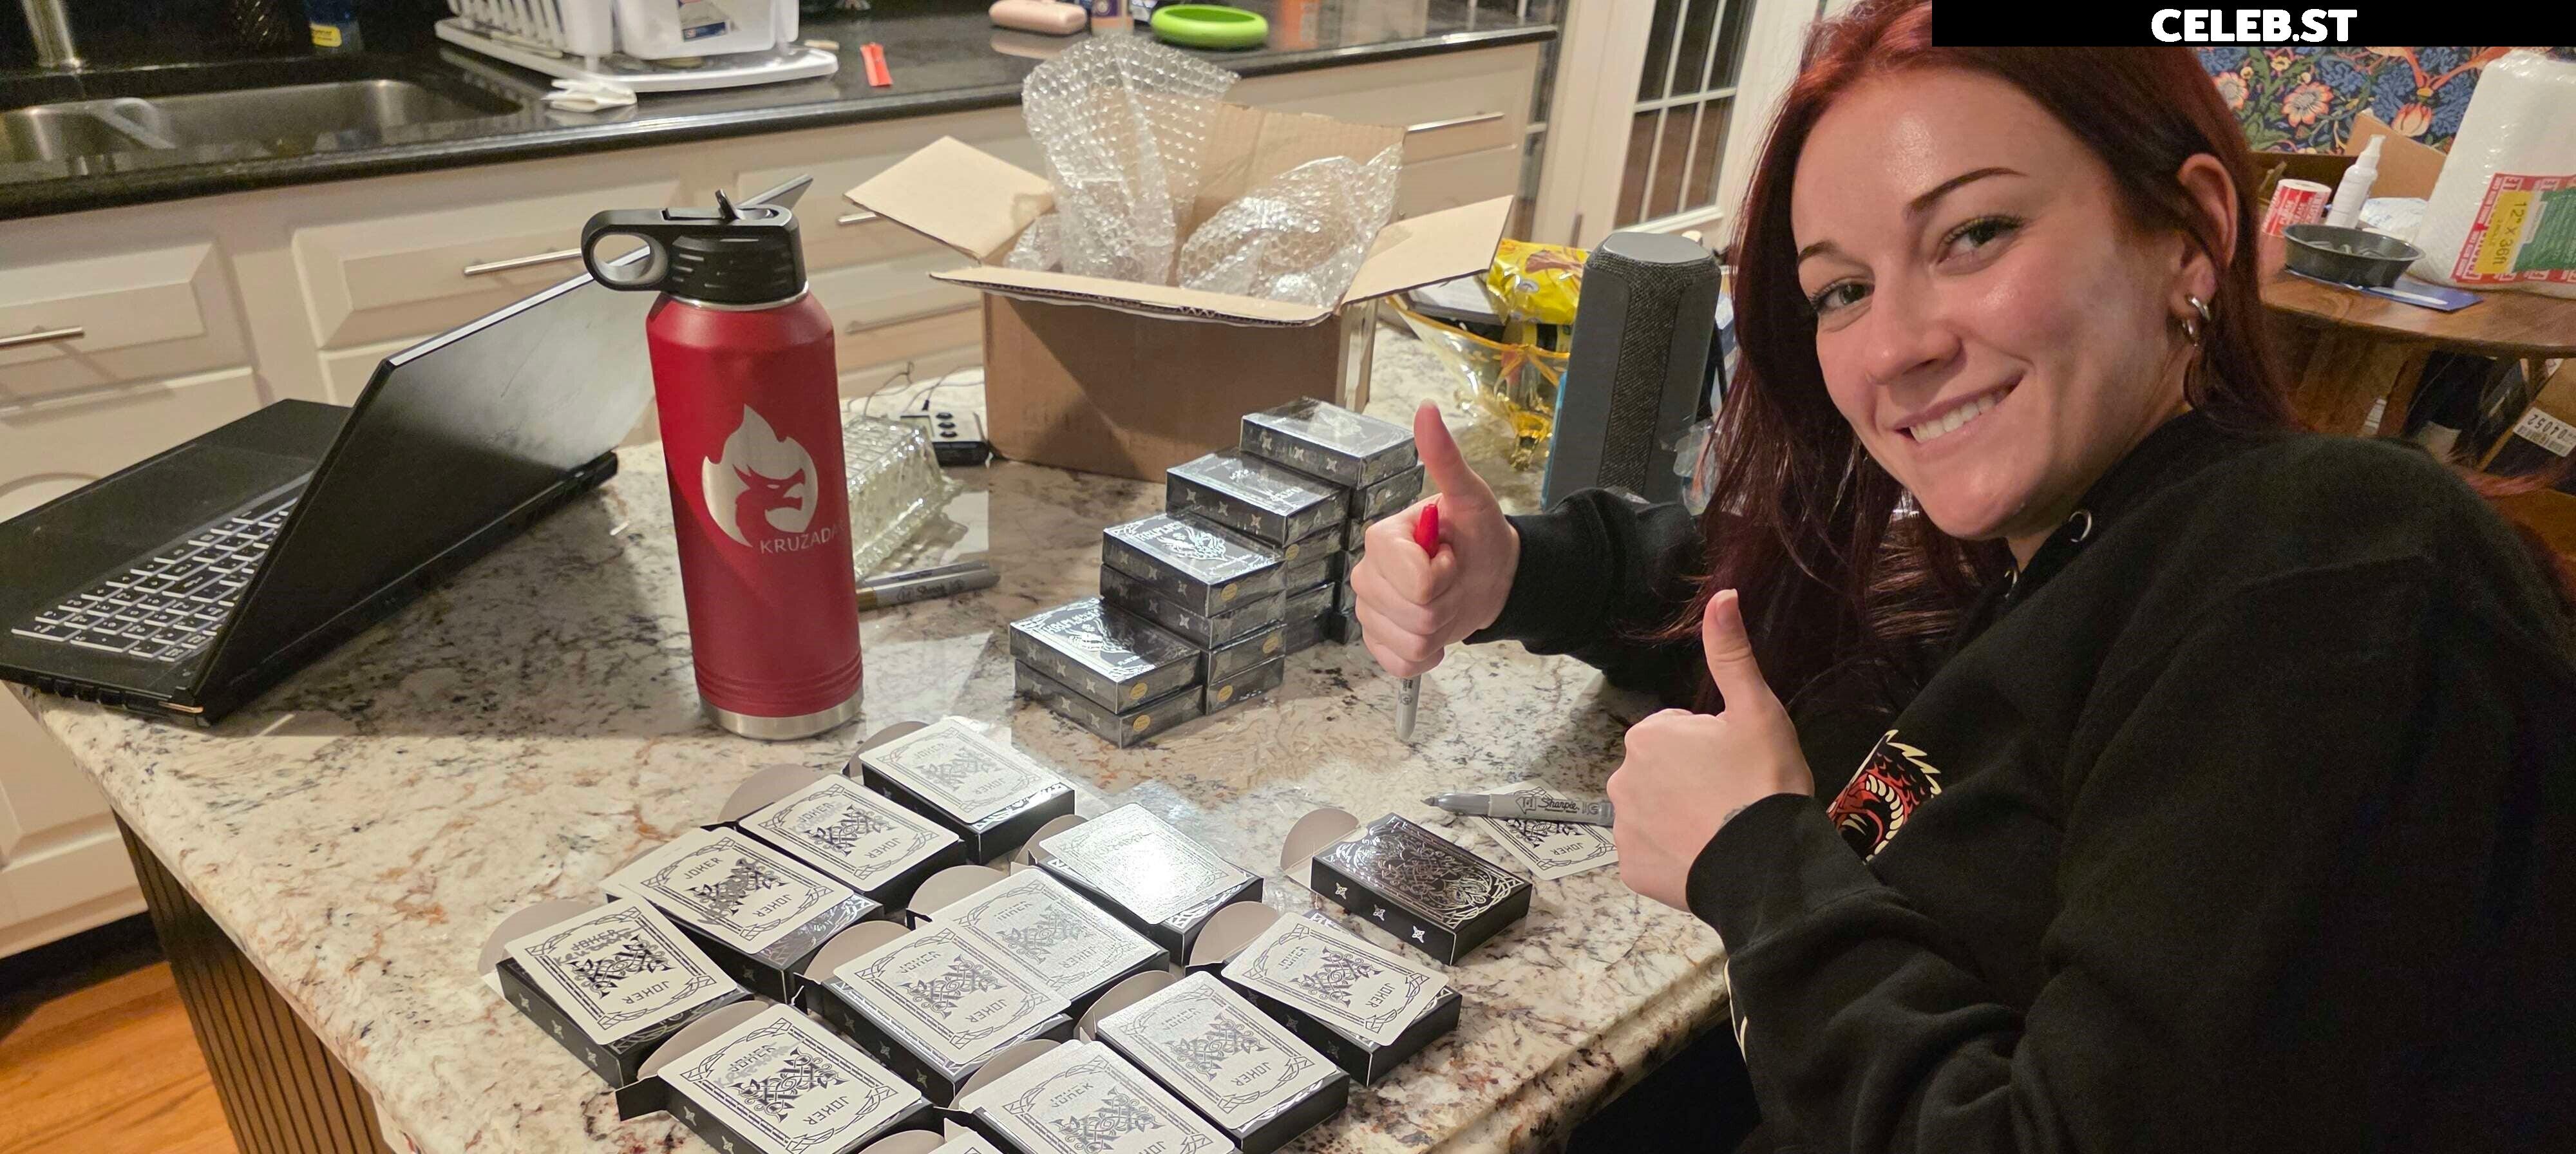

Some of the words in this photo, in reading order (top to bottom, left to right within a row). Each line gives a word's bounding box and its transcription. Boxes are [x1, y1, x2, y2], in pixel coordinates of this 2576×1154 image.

[797, 802, 835, 822] JOKER
[864, 837, 902, 858] JOKER
[1550, 842, 1585, 856] JOKER
[683, 857, 723, 880] JOKER
[752, 894, 793, 917] JOKER
[621, 981, 670, 1004] JOKER
[1365, 983, 1396, 1008] JOKER
[965, 999, 1008, 1023] JOKER
[1231, 1062, 1272, 1086] JOKER
[803, 1096, 849, 1125] JOKER
